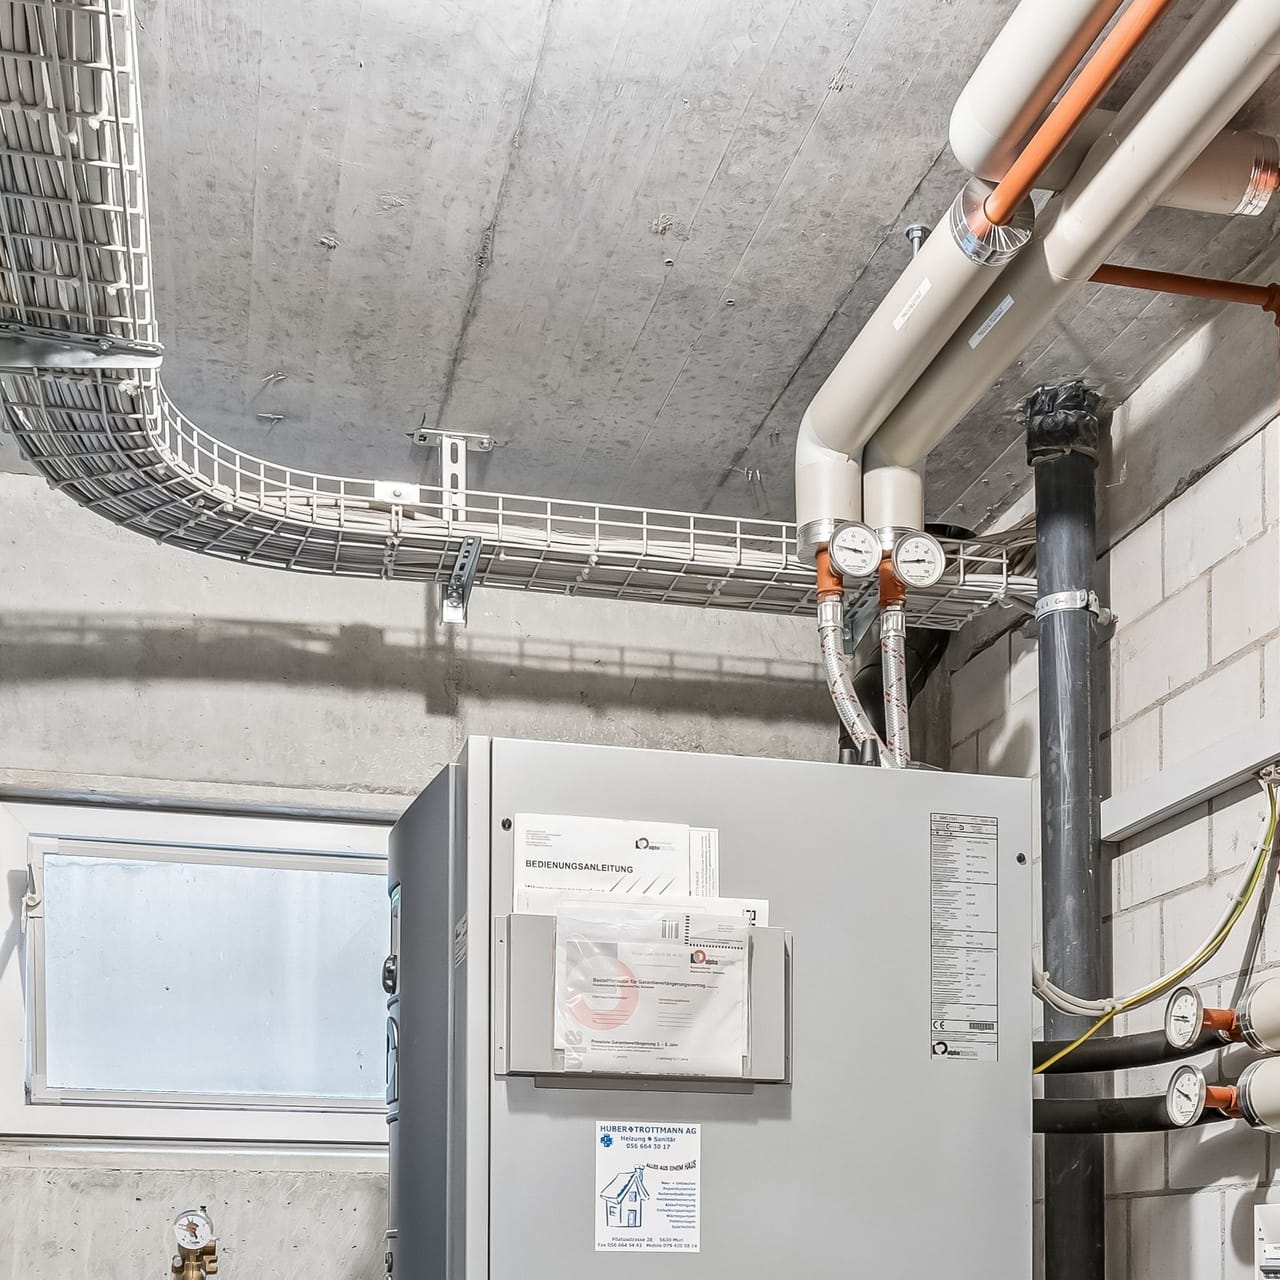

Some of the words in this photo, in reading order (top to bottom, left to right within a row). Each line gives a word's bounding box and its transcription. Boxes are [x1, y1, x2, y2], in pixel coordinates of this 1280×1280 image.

[525, 859, 634, 873] BEDIENUNGSANLEITUNG
[635, 1126, 684, 1134] TROTTMANN
[684, 1160, 697, 1170] HAUS
